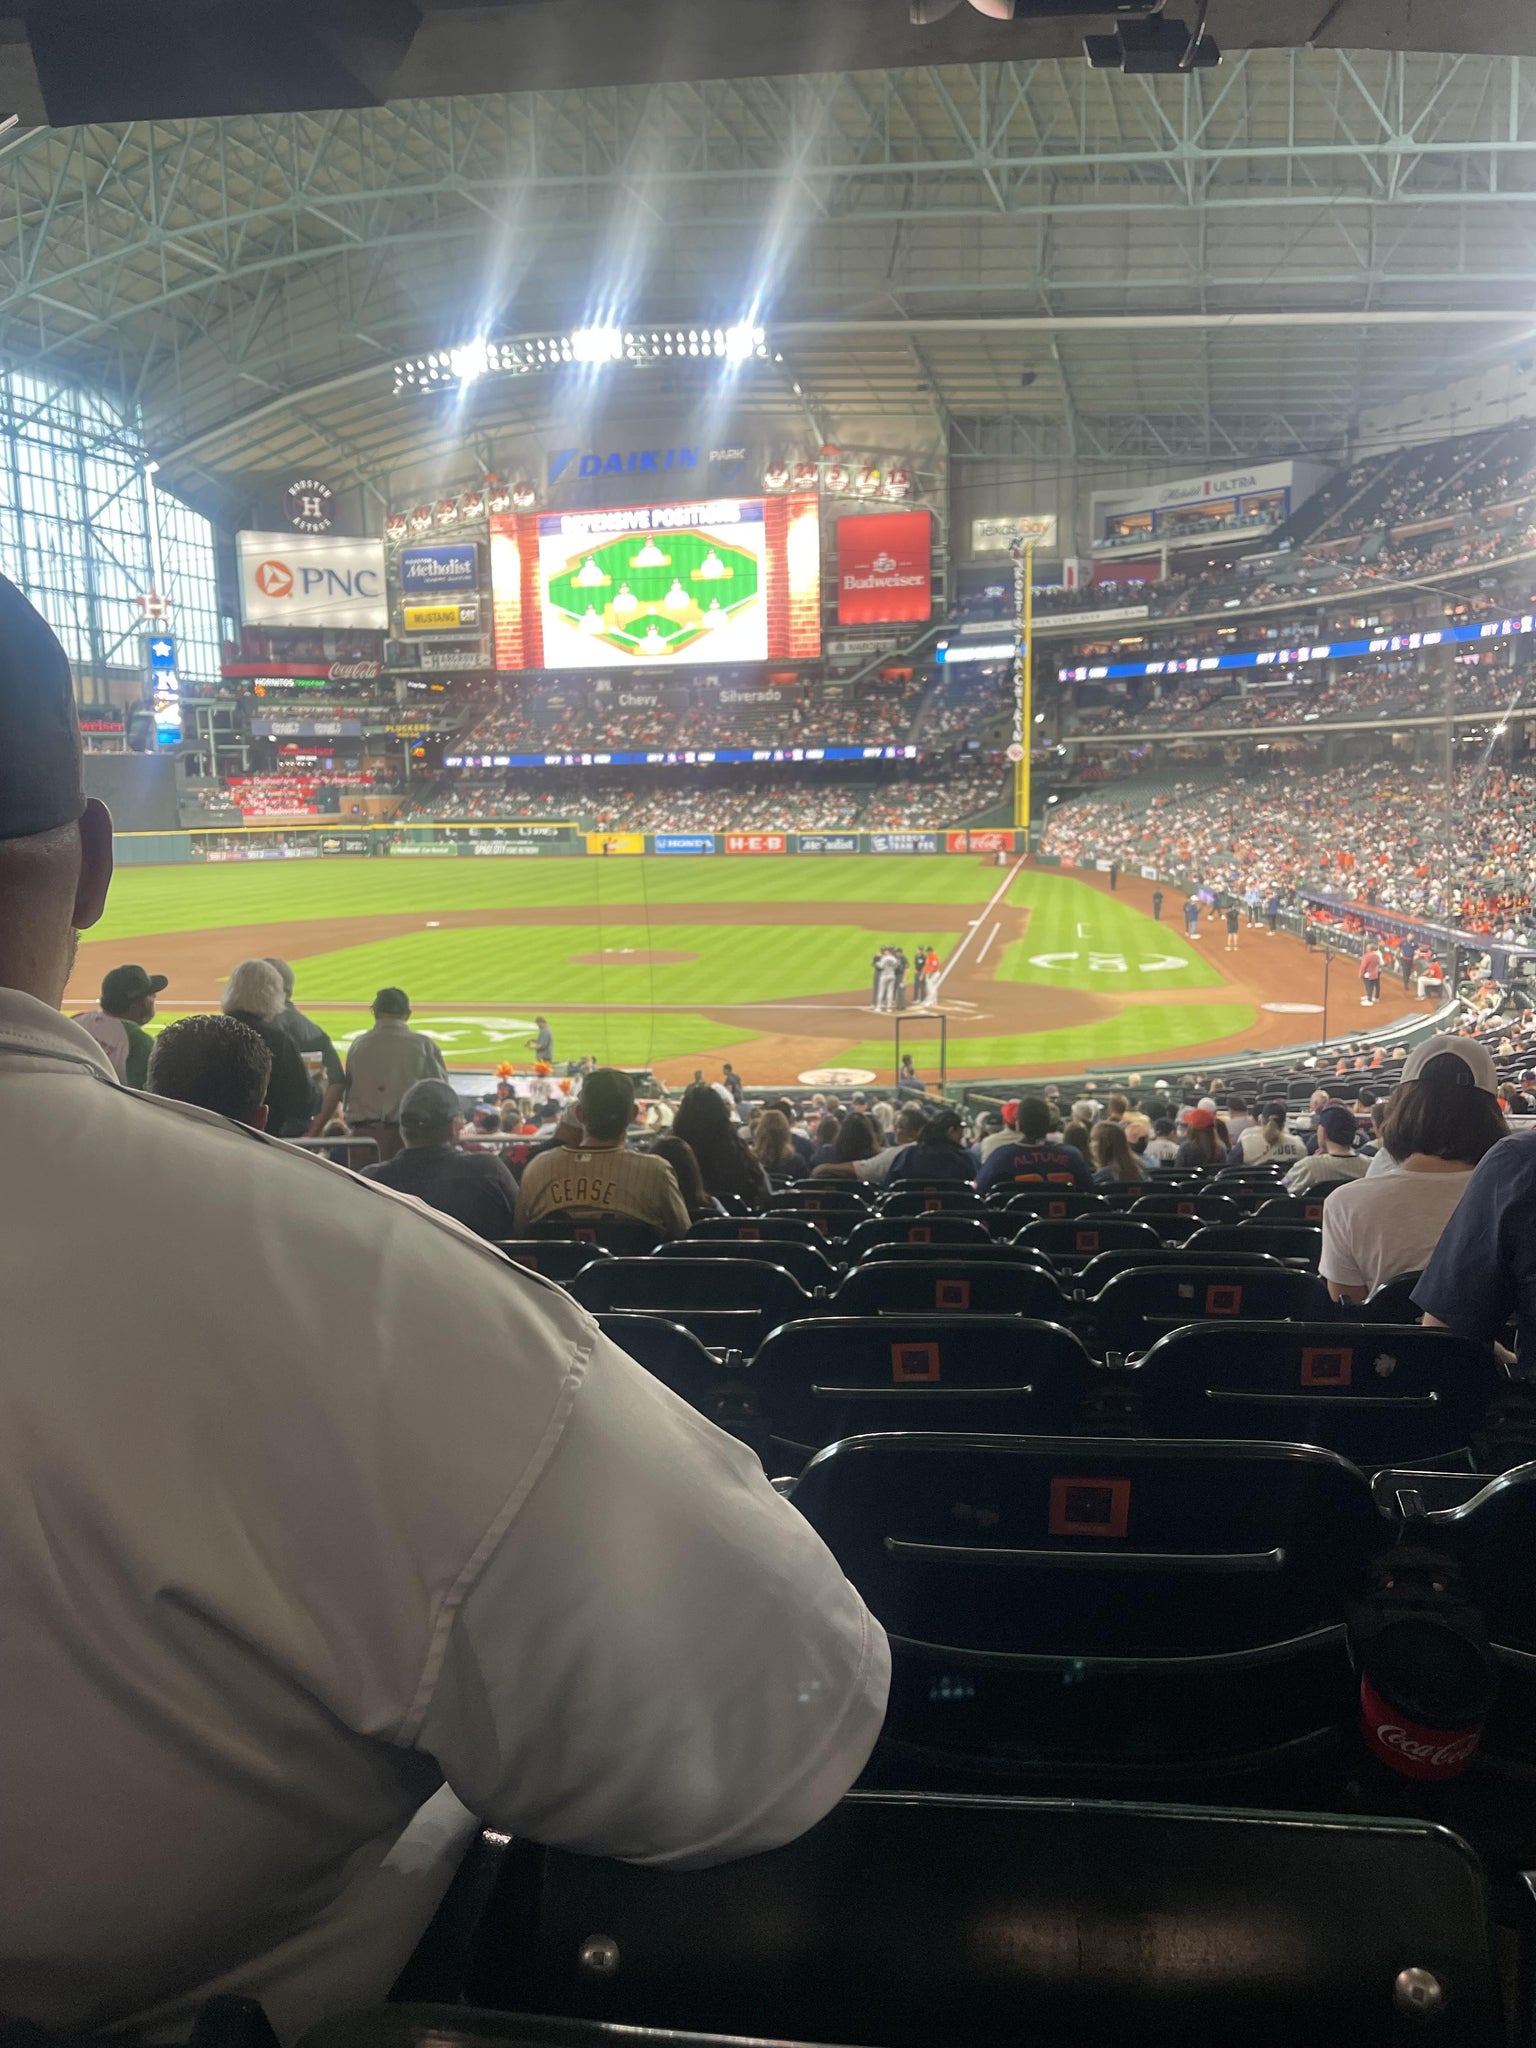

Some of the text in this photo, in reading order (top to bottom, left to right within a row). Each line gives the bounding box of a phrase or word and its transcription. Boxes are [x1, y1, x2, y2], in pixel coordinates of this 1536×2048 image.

[578, 447, 746, 477] DAIKIN PARK
[289, 480, 332, 498] HOUSTON
[1213, 476, 1257, 492] ULTRA
[301, 497, 322, 518] H
[292, 517, 332, 532] ASTROS
[978, 518, 1050, 537] Texas Bay
[406, 559, 472, 577] Methodist
[302, 567, 379, 598] PNC
[843, 573, 925, 590] Budweiser
[143, 592, 166, 619] H
[414, 609, 476, 624] MUSTANG CAT
[618, 689, 782, 707] Chevy Silverado
[667, 839, 713, 848] HONDA
[729, 837, 782, 850] H-E-B
[889, 842, 935, 850] TRANFER
[1263, 1144, 1297, 1156] JDGE
[1013, 1152, 1070, 1166] ALTUVE
[550, 1178, 617, 1205] CEASE
